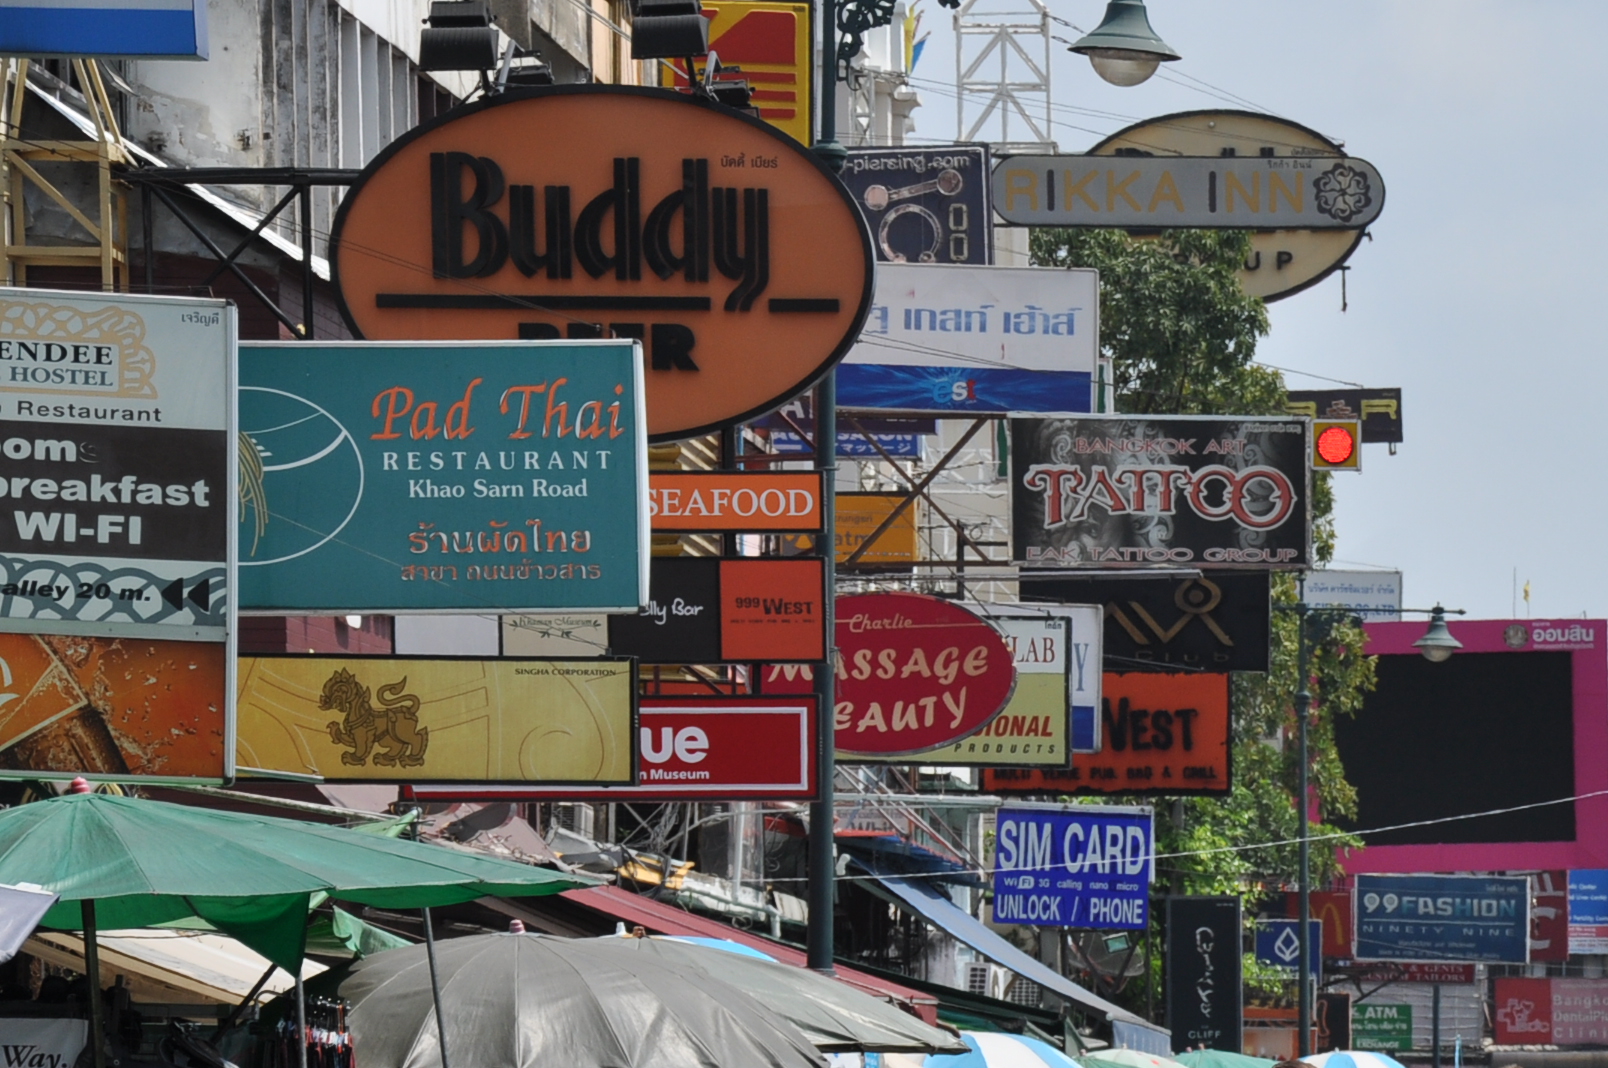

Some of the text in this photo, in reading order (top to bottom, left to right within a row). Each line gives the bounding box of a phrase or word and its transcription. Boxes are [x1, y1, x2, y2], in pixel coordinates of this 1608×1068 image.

[751, 155, 778, 169] เบียร์
[1004, 169, 1304, 213] RIKKA INN
[430, 151, 770, 312] Buddy
[904, 304, 996, 332] เกสท์
[1003, 304, 1082, 336] เฮ้าส์
[9, 366, 113, 387] HOSTEL
[932, 378, 976, 403] est
[17, 401, 162, 422] Restaurant
[370, 377, 626, 440] Pad Thai
[1075, 437, 1247, 455] BANGKOK ART
[383, 451, 611, 470] RESTAURANT
[409, 478, 587, 498] Khao Sarn Road
[1023, 464, 1298, 531] TATTOO
[649, 488, 813, 516] SEAFOOD
[14, 510, 142, 544] WI-FI
[408, 519, 591, 553] ร้านผัดไทย
[1026, 547, 1298, 562] EAK TATTOO GROUP
[401, 559, 601, 581] สาขา ถนนข้าวสาร
[2, 580, 151, 601] alley 20 m.
[672, 598, 703, 617] Bar
[735, 597, 814, 615] 999 WEST
[849, 614, 913, 633] Charlie
[1533, 624, 1594, 642] ออมสิน
[515, 668, 616, 677] SINGHA CORPORATION
[834, 686, 967, 733] EAUTY
[954, 743, 1055, 754] PRODUCTS
[650, 769, 710, 781] Museum
[999, 820, 1145, 875] SIM CARD
[1057, 879, 1082, 891] calling
[1090, 881, 1109, 889] nano
[1116, 881, 1139, 891] micro
[997, 894, 1061, 921] UNLOCK
[1090, 898, 1144, 924] PHONE
[1363, 925, 1515, 936] NINETY NINE
[1365, 1007, 1398, 1018] ATM
